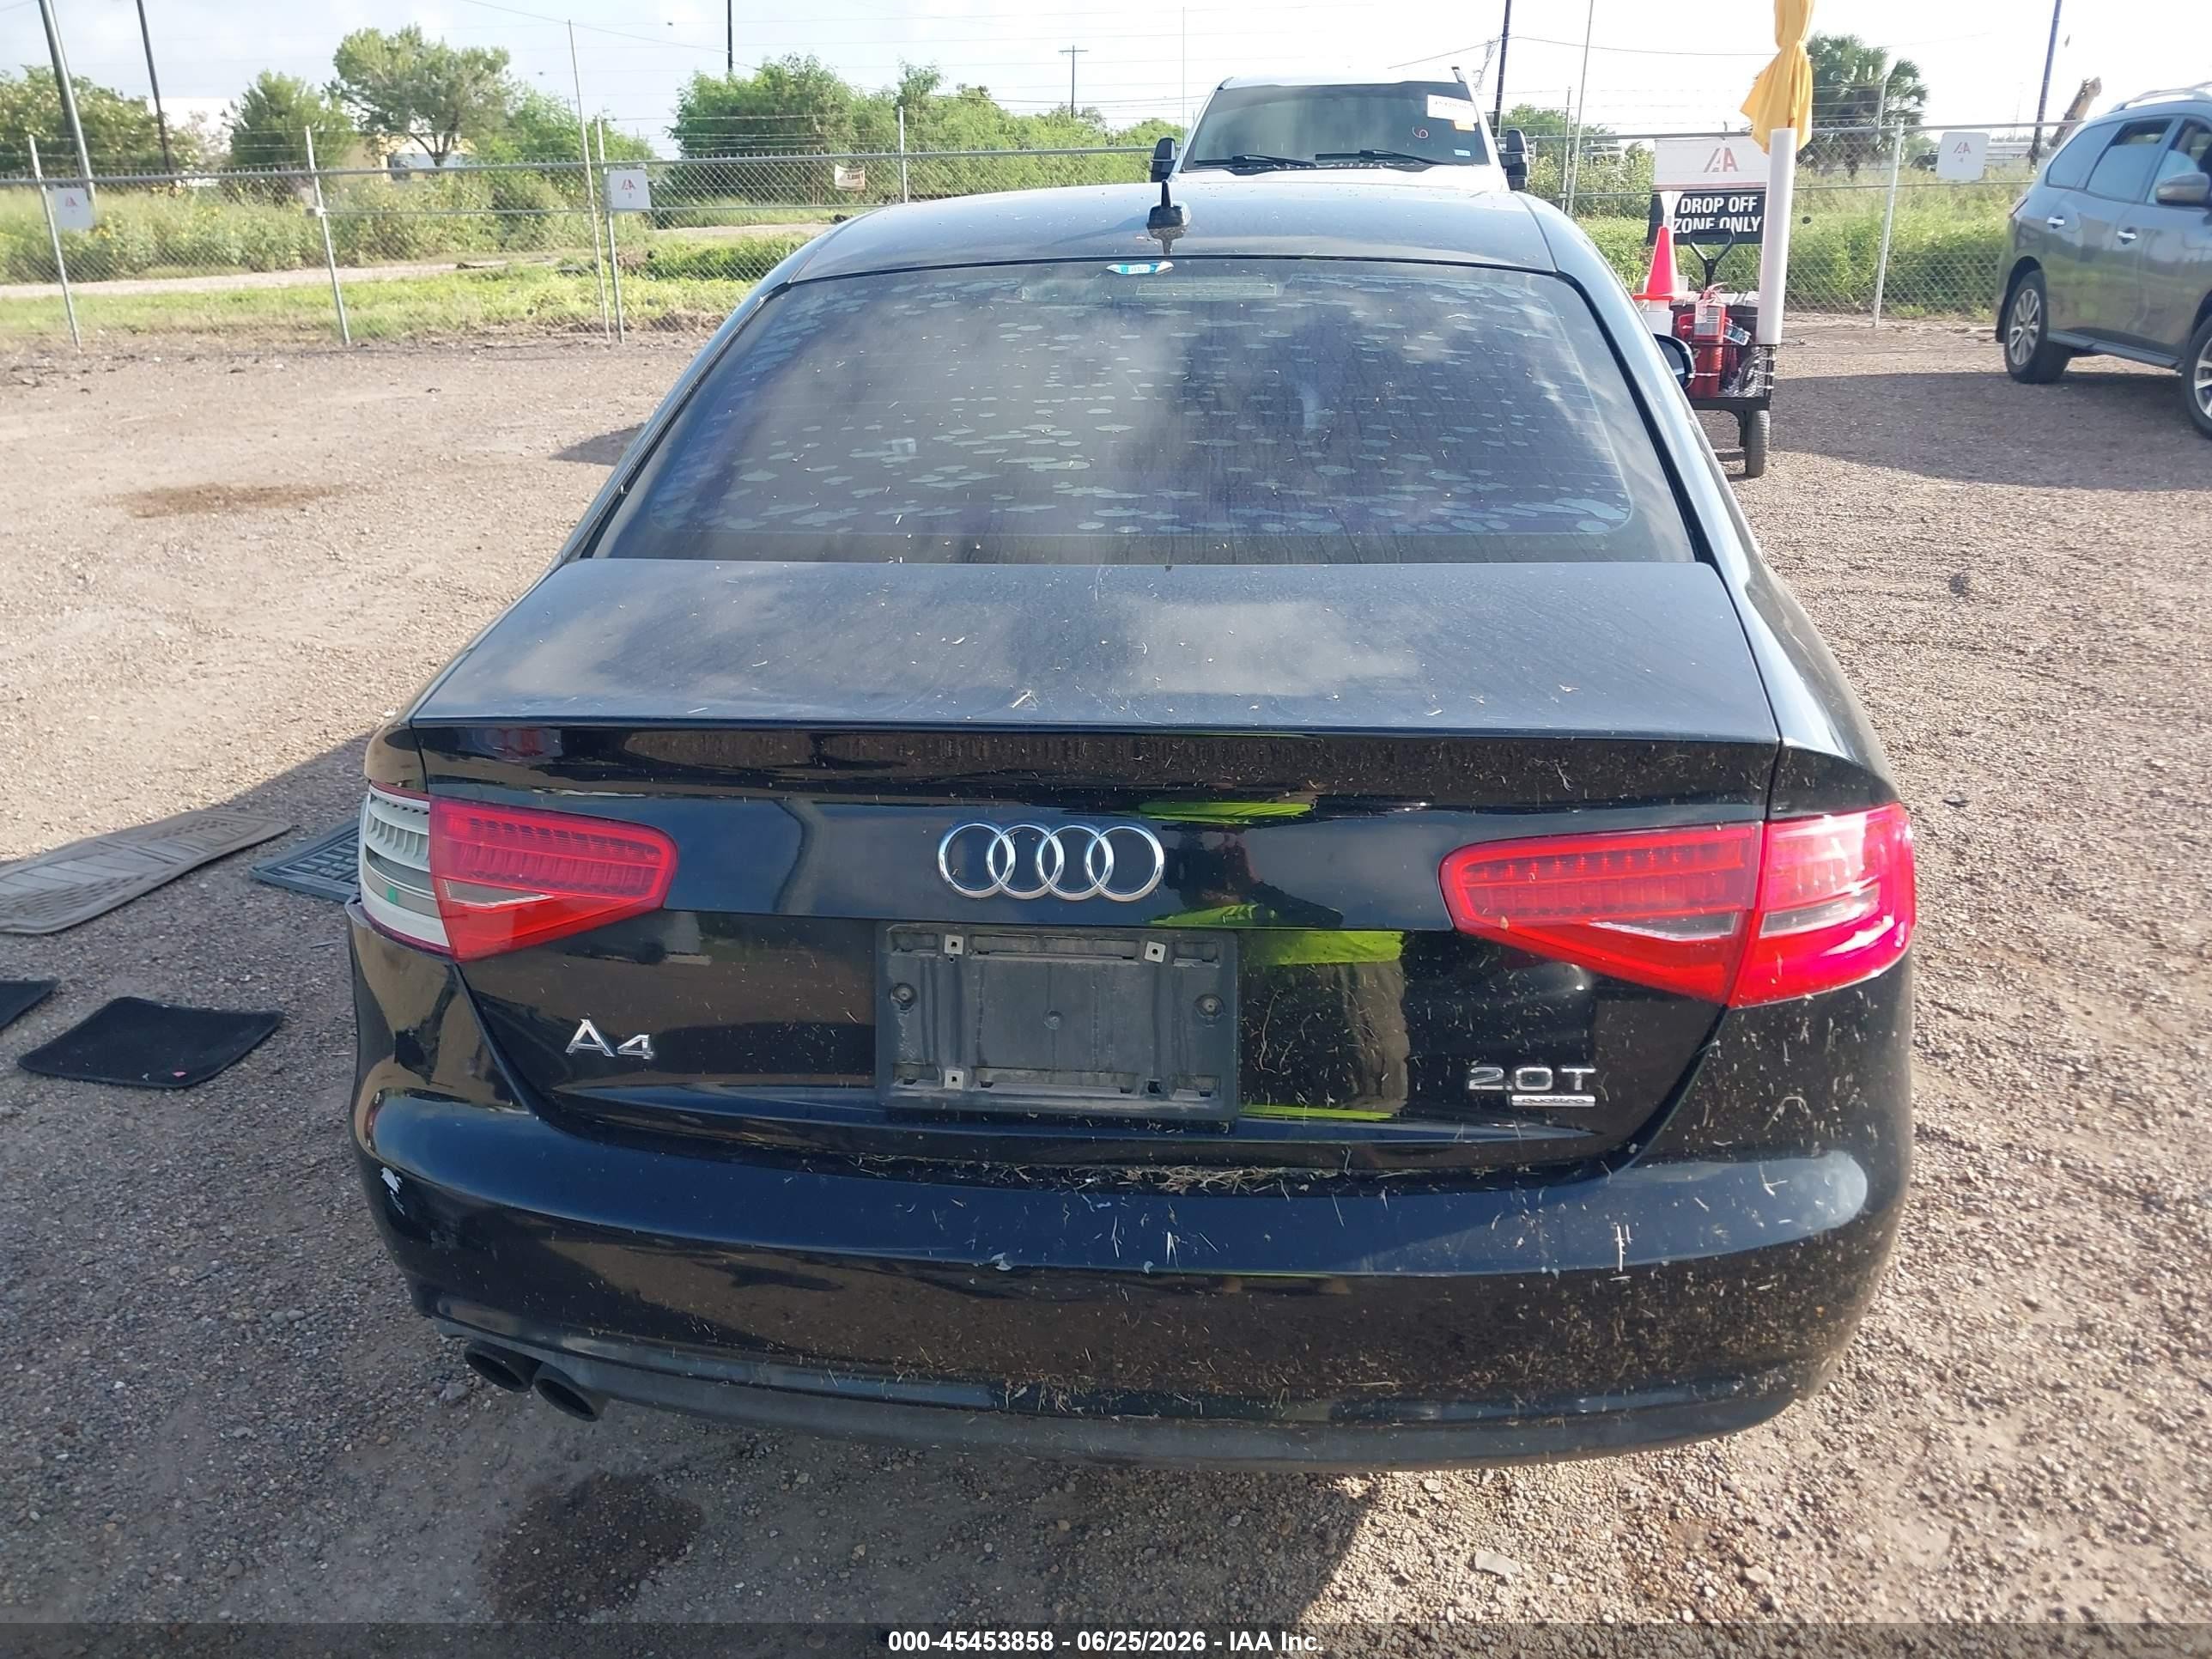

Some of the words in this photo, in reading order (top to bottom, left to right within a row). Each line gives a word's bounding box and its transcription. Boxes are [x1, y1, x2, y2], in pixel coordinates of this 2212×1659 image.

[1680, 197, 1725, 214] DROP
[1728, 196, 1758, 212] OFF
[1674, 217, 1716, 234] ZONE
[1719, 216, 1762, 232] ONLY
[565, 1018, 654, 1060] A4
